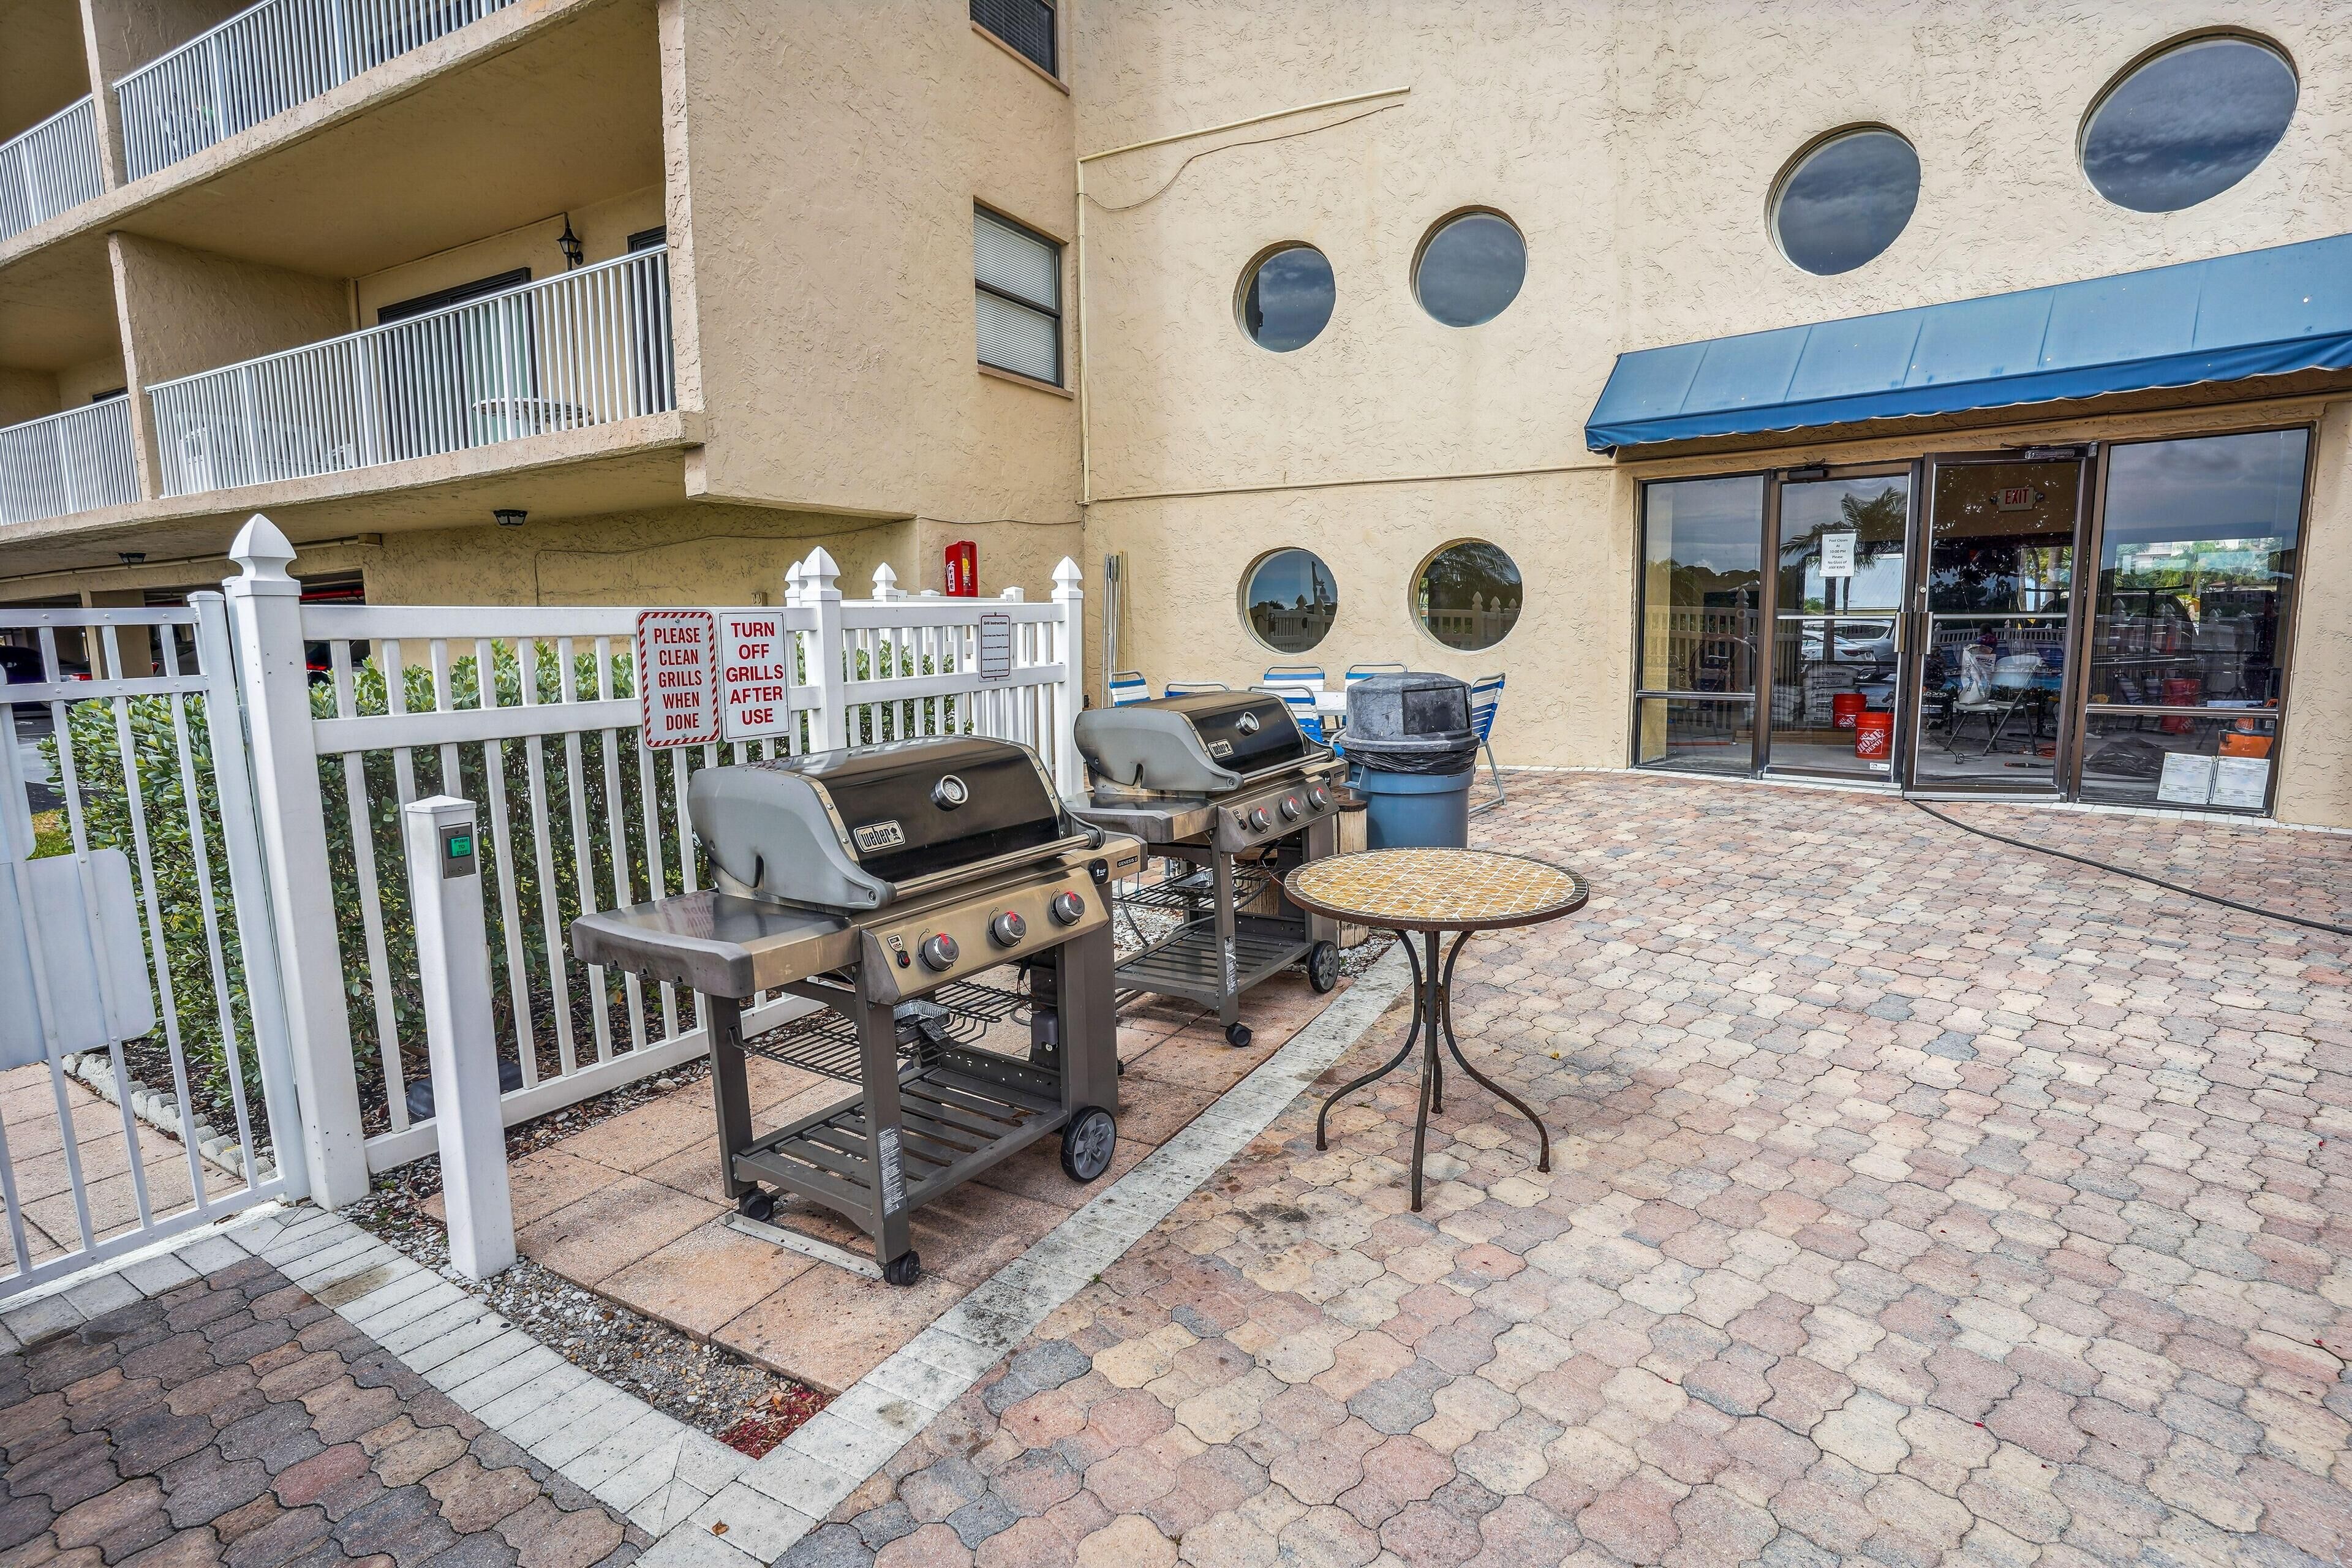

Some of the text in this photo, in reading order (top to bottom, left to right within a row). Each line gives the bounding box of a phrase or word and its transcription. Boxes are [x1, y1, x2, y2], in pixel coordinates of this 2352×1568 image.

[2005, 489, 2029, 505] EXIT
[654, 627, 701, 644] PLEASE
[730, 622, 775, 638] TURN
[659, 649, 699, 666] CLEAN
[739, 643, 770, 660] OFF
[658, 669, 703, 688] GRILLS
[726, 664, 784, 683] GRILLS
[662, 692, 700, 709] WHEN
[729, 685, 783, 705] AFTER
[666, 712, 700, 731] DONE
[742, 707, 774, 725] USE
[1856, 729, 1883, 753] HOME
[1859, 731, 1870, 741] THE
[1865, 738, 1883, 754] DEPOT
[860, 827, 891, 847] weber
[1118, 858, 1134, 867] GENESIS
